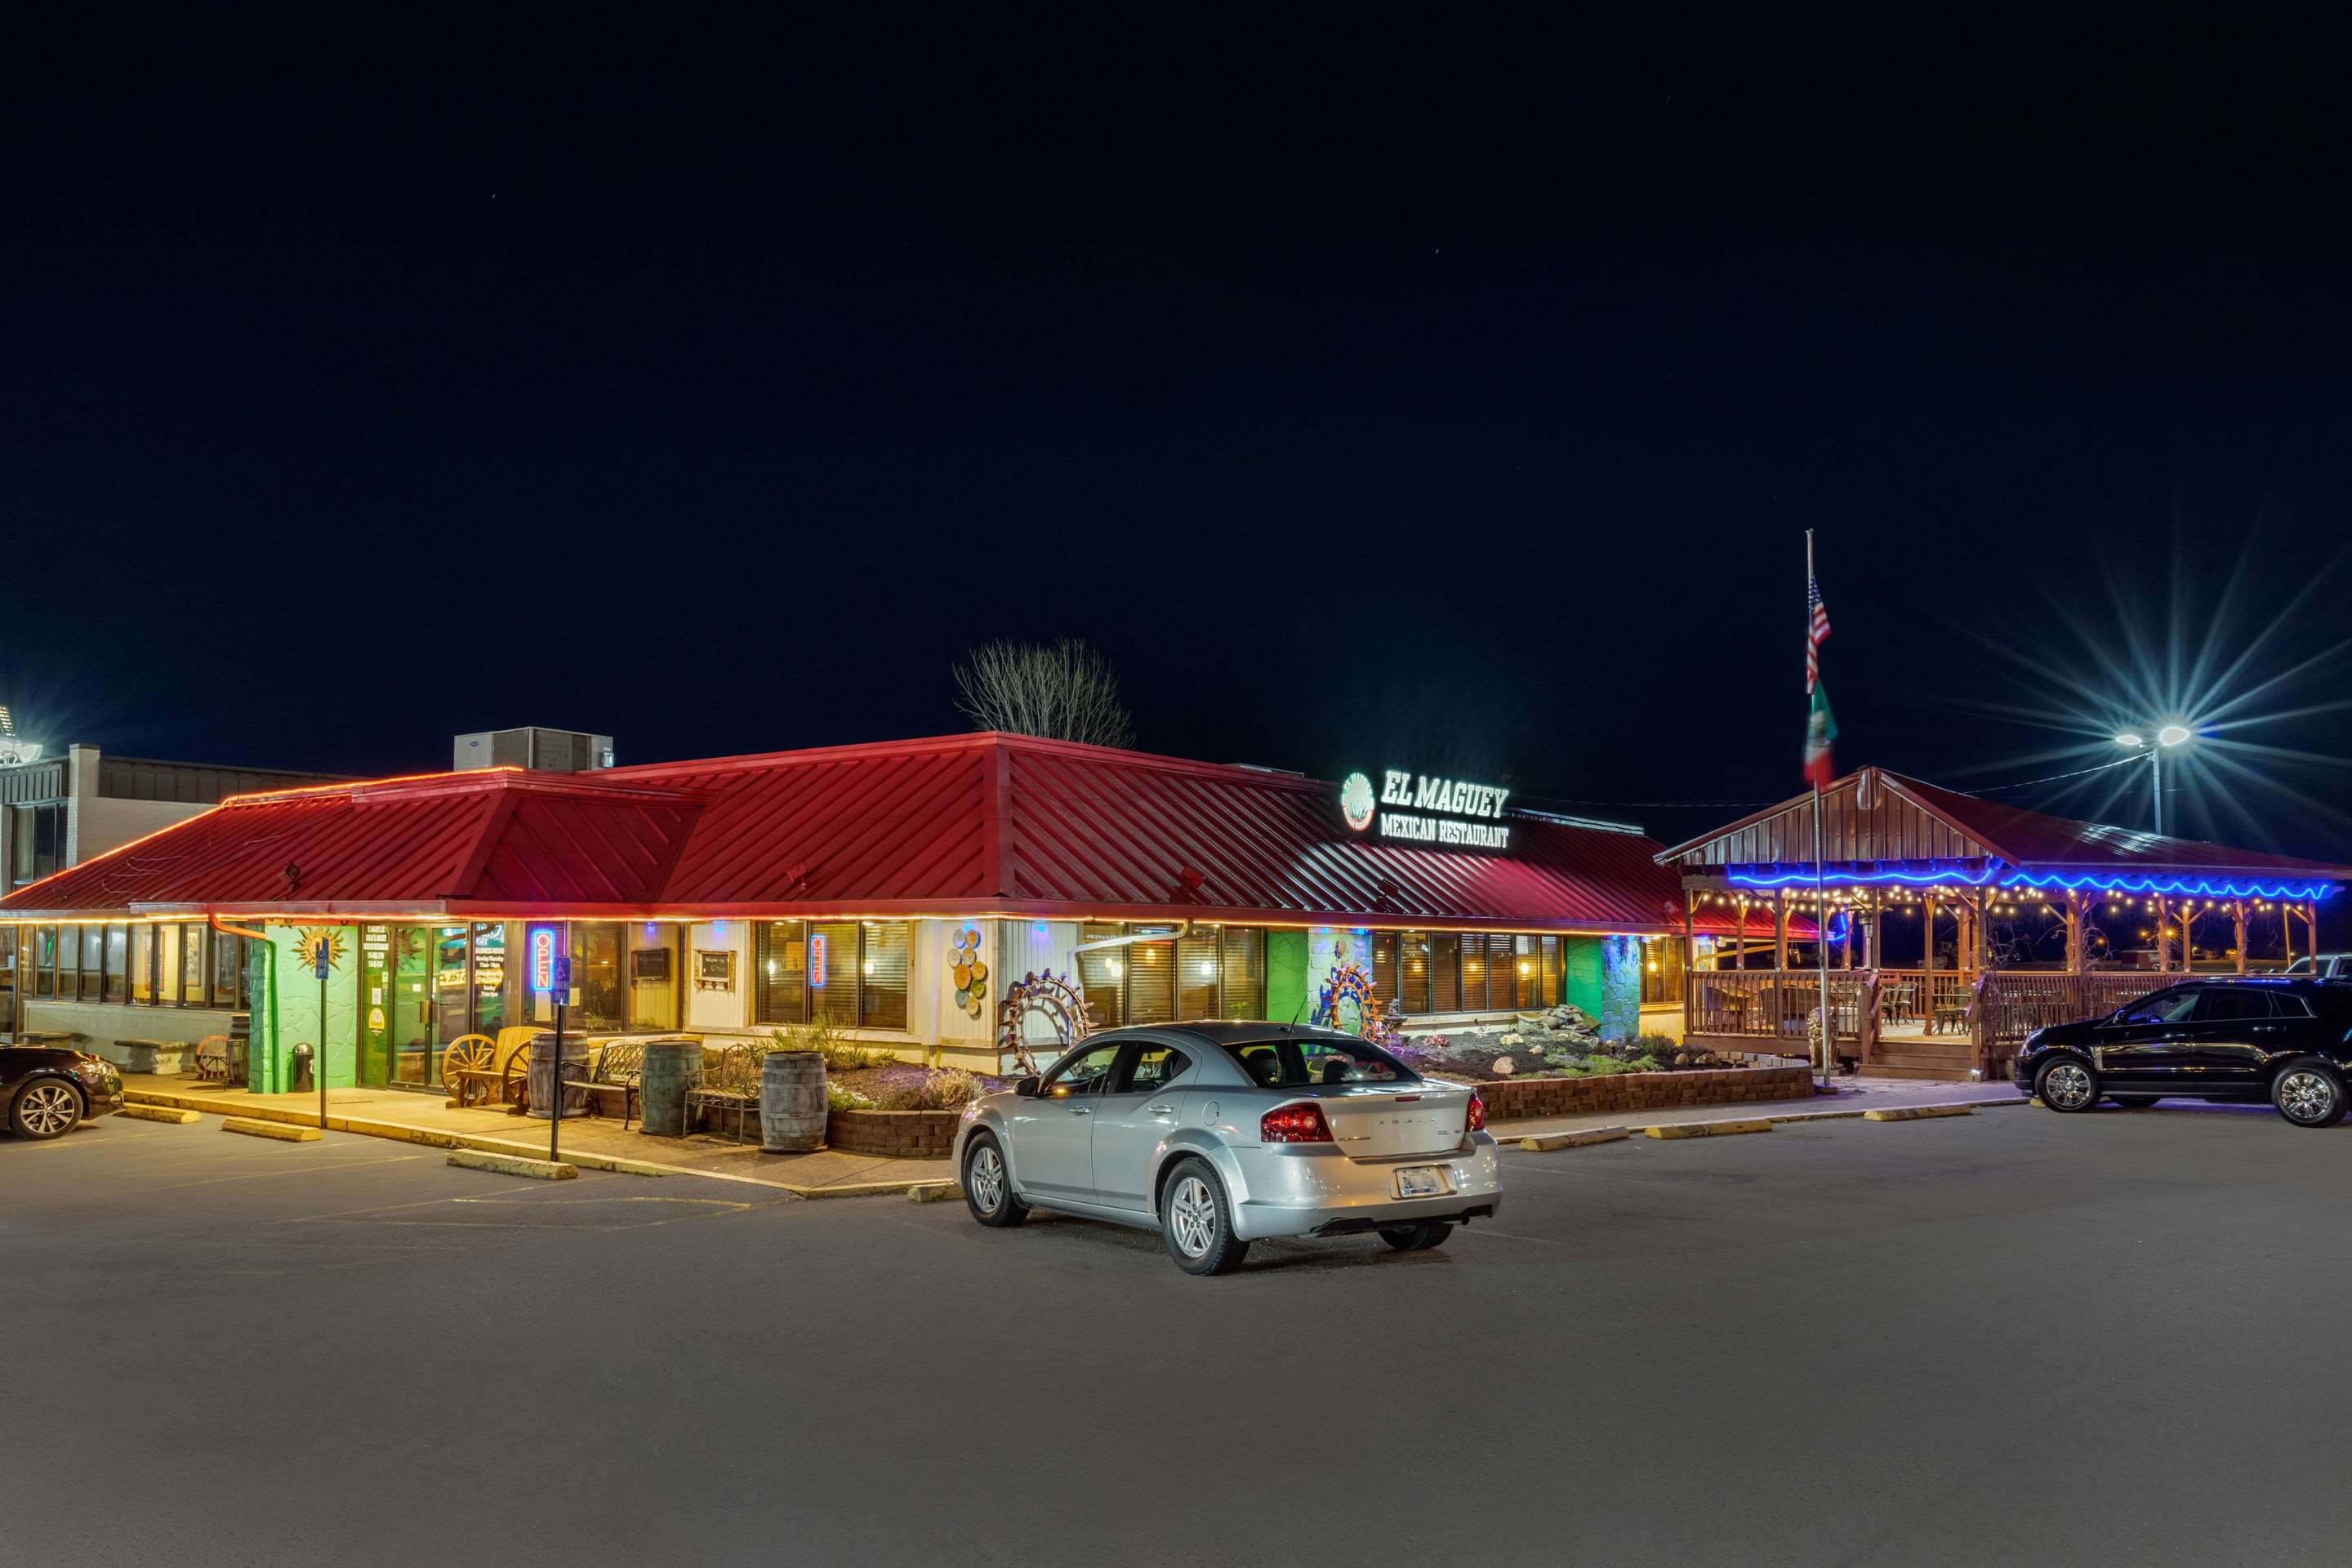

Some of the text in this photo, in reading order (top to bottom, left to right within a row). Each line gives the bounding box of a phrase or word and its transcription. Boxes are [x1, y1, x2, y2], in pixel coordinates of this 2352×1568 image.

[1381, 770, 1509, 817] EL MAGUEY
[1380, 813, 1509, 848] MEXICAN RESTAURANT
[537, 933, 550, 987] OPEN
